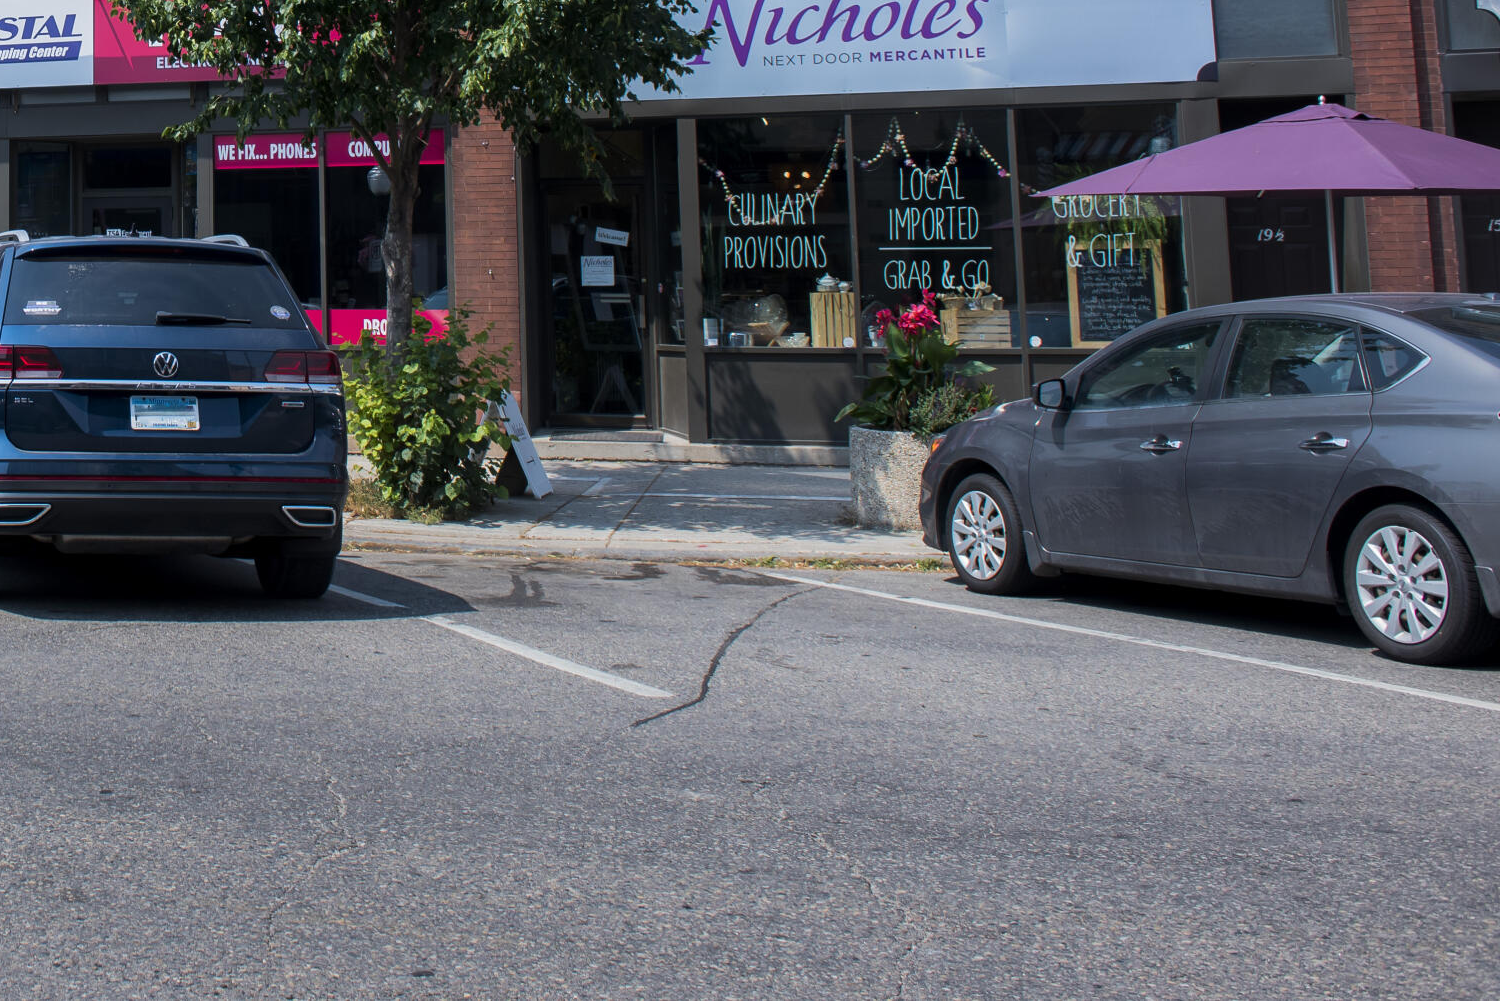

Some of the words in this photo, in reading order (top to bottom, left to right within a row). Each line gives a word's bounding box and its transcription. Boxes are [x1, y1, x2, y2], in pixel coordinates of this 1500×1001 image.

[29, 45, 68, 60] Center
[763, 54, 806, 67] NEXT
[813, 52, 862, 66] DOOR
[869, 47, 987, 63] MERCANTILE
[218, 145, 235, 160] WE
[238, 144, 267, 160] FIX...
[270, 143, 317, 159] PHONES
[899, 167, 964, 200] LOCAL
[728, 192, 819, 226] CULINARY
[889, 206, 979, 240] IMPORTED
[724, 235, 827, 268] PROVISIONS
[1066, 235, 1082, 267] &
[1090, 233, 1136, 267] GIFT
[884, 260, 932, 289] GRAB
[942, 260, 956, 289] &
[962, 260, 989, 290] GO
